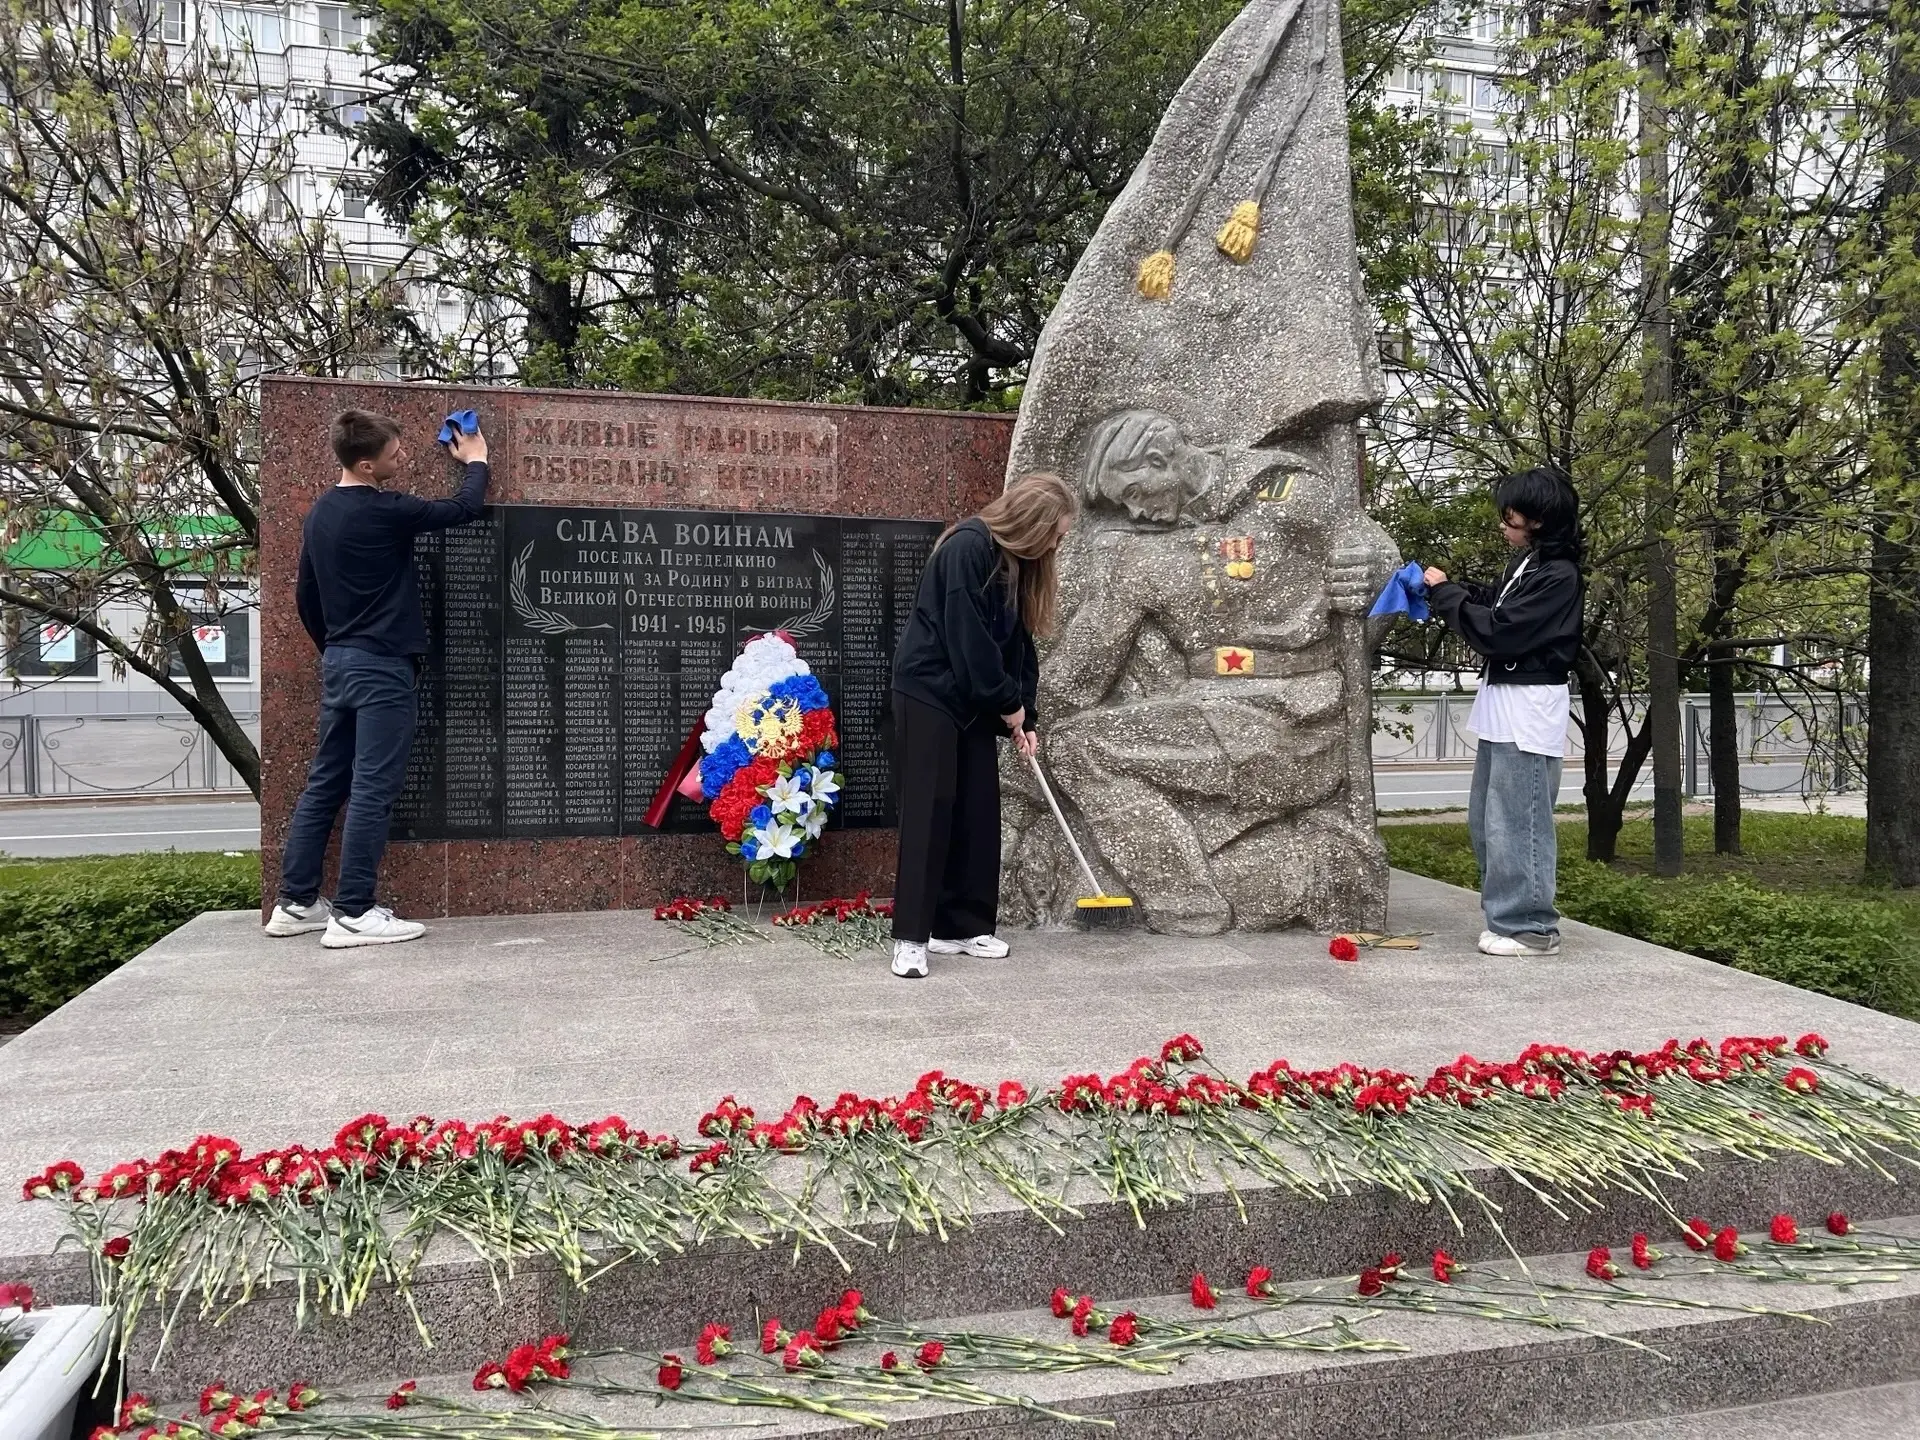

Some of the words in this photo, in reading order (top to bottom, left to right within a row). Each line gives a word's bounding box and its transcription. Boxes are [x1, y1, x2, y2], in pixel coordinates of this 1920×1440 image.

[521, 418, 658, 449] ЖИВЫЕ
[556, 518, 659, 545] СЛАВА
[674, 523, 795, 548] ВОИНАМ
[578, 550, 654, 565] ПОСЕЛКА
[660, 548, 776, 569] ПЕРЕДЕЛКИНО
[540, 570, 635, 586] ПОГИБШИМ
[644, 572, 662, 586] ЗА
[668, 569, 733, 588] РОДИНУ
[740, 576, 749, 588] В
[757, 576, 813, 590] БИТВАХ
[540, 586, 617, 606] ВЕЛИКОЙ
[625, 589, 755, 608] ОТЕЧЕСТВЕННОЙ
[760, 593, 812, 610] ВОЙНЫ
[631, 614, 668, 633] 1941
[687, 616, 726, 634] 1945
